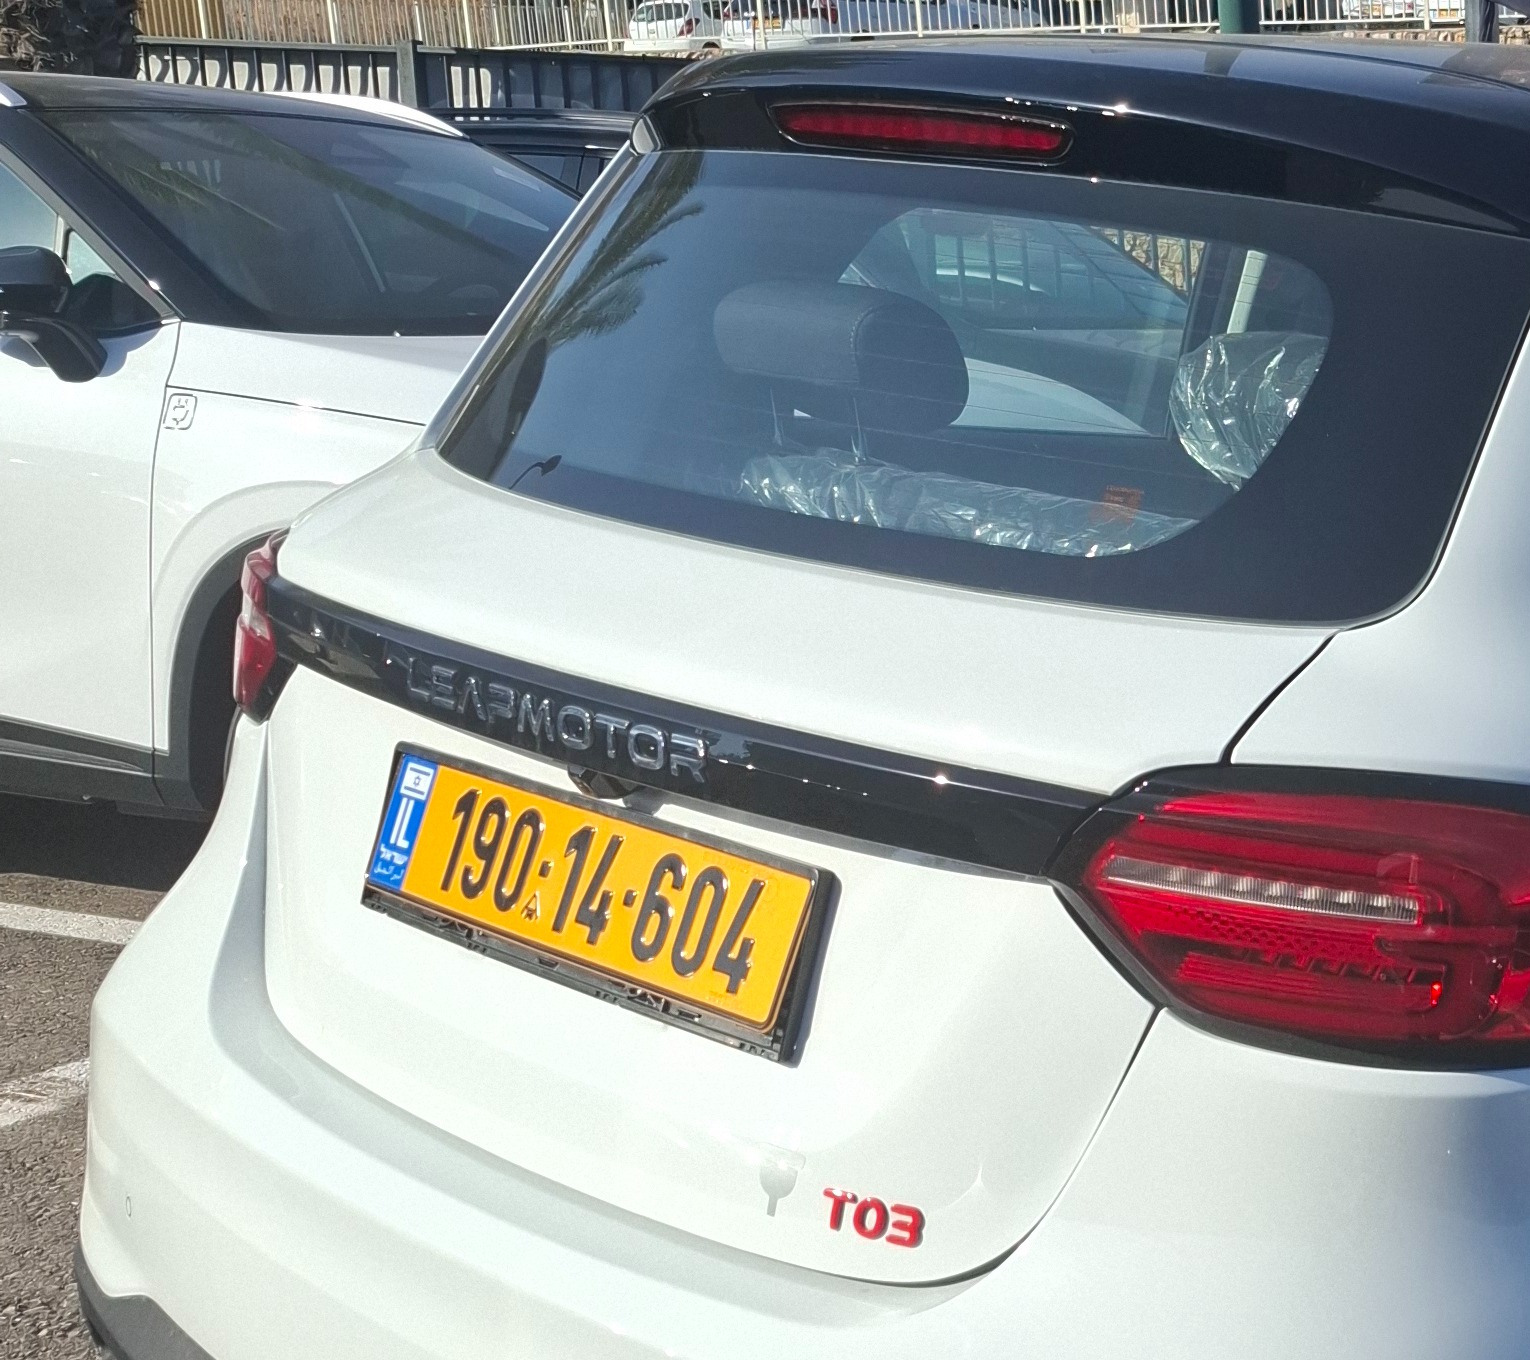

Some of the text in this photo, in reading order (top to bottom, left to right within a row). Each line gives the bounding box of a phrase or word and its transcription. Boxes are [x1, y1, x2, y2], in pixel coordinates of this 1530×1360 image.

[405, 655, 708, 782] LEAPMOTOR
[390, 797, 415, 848] IL
[380, 843, 408, 865] ישראל
